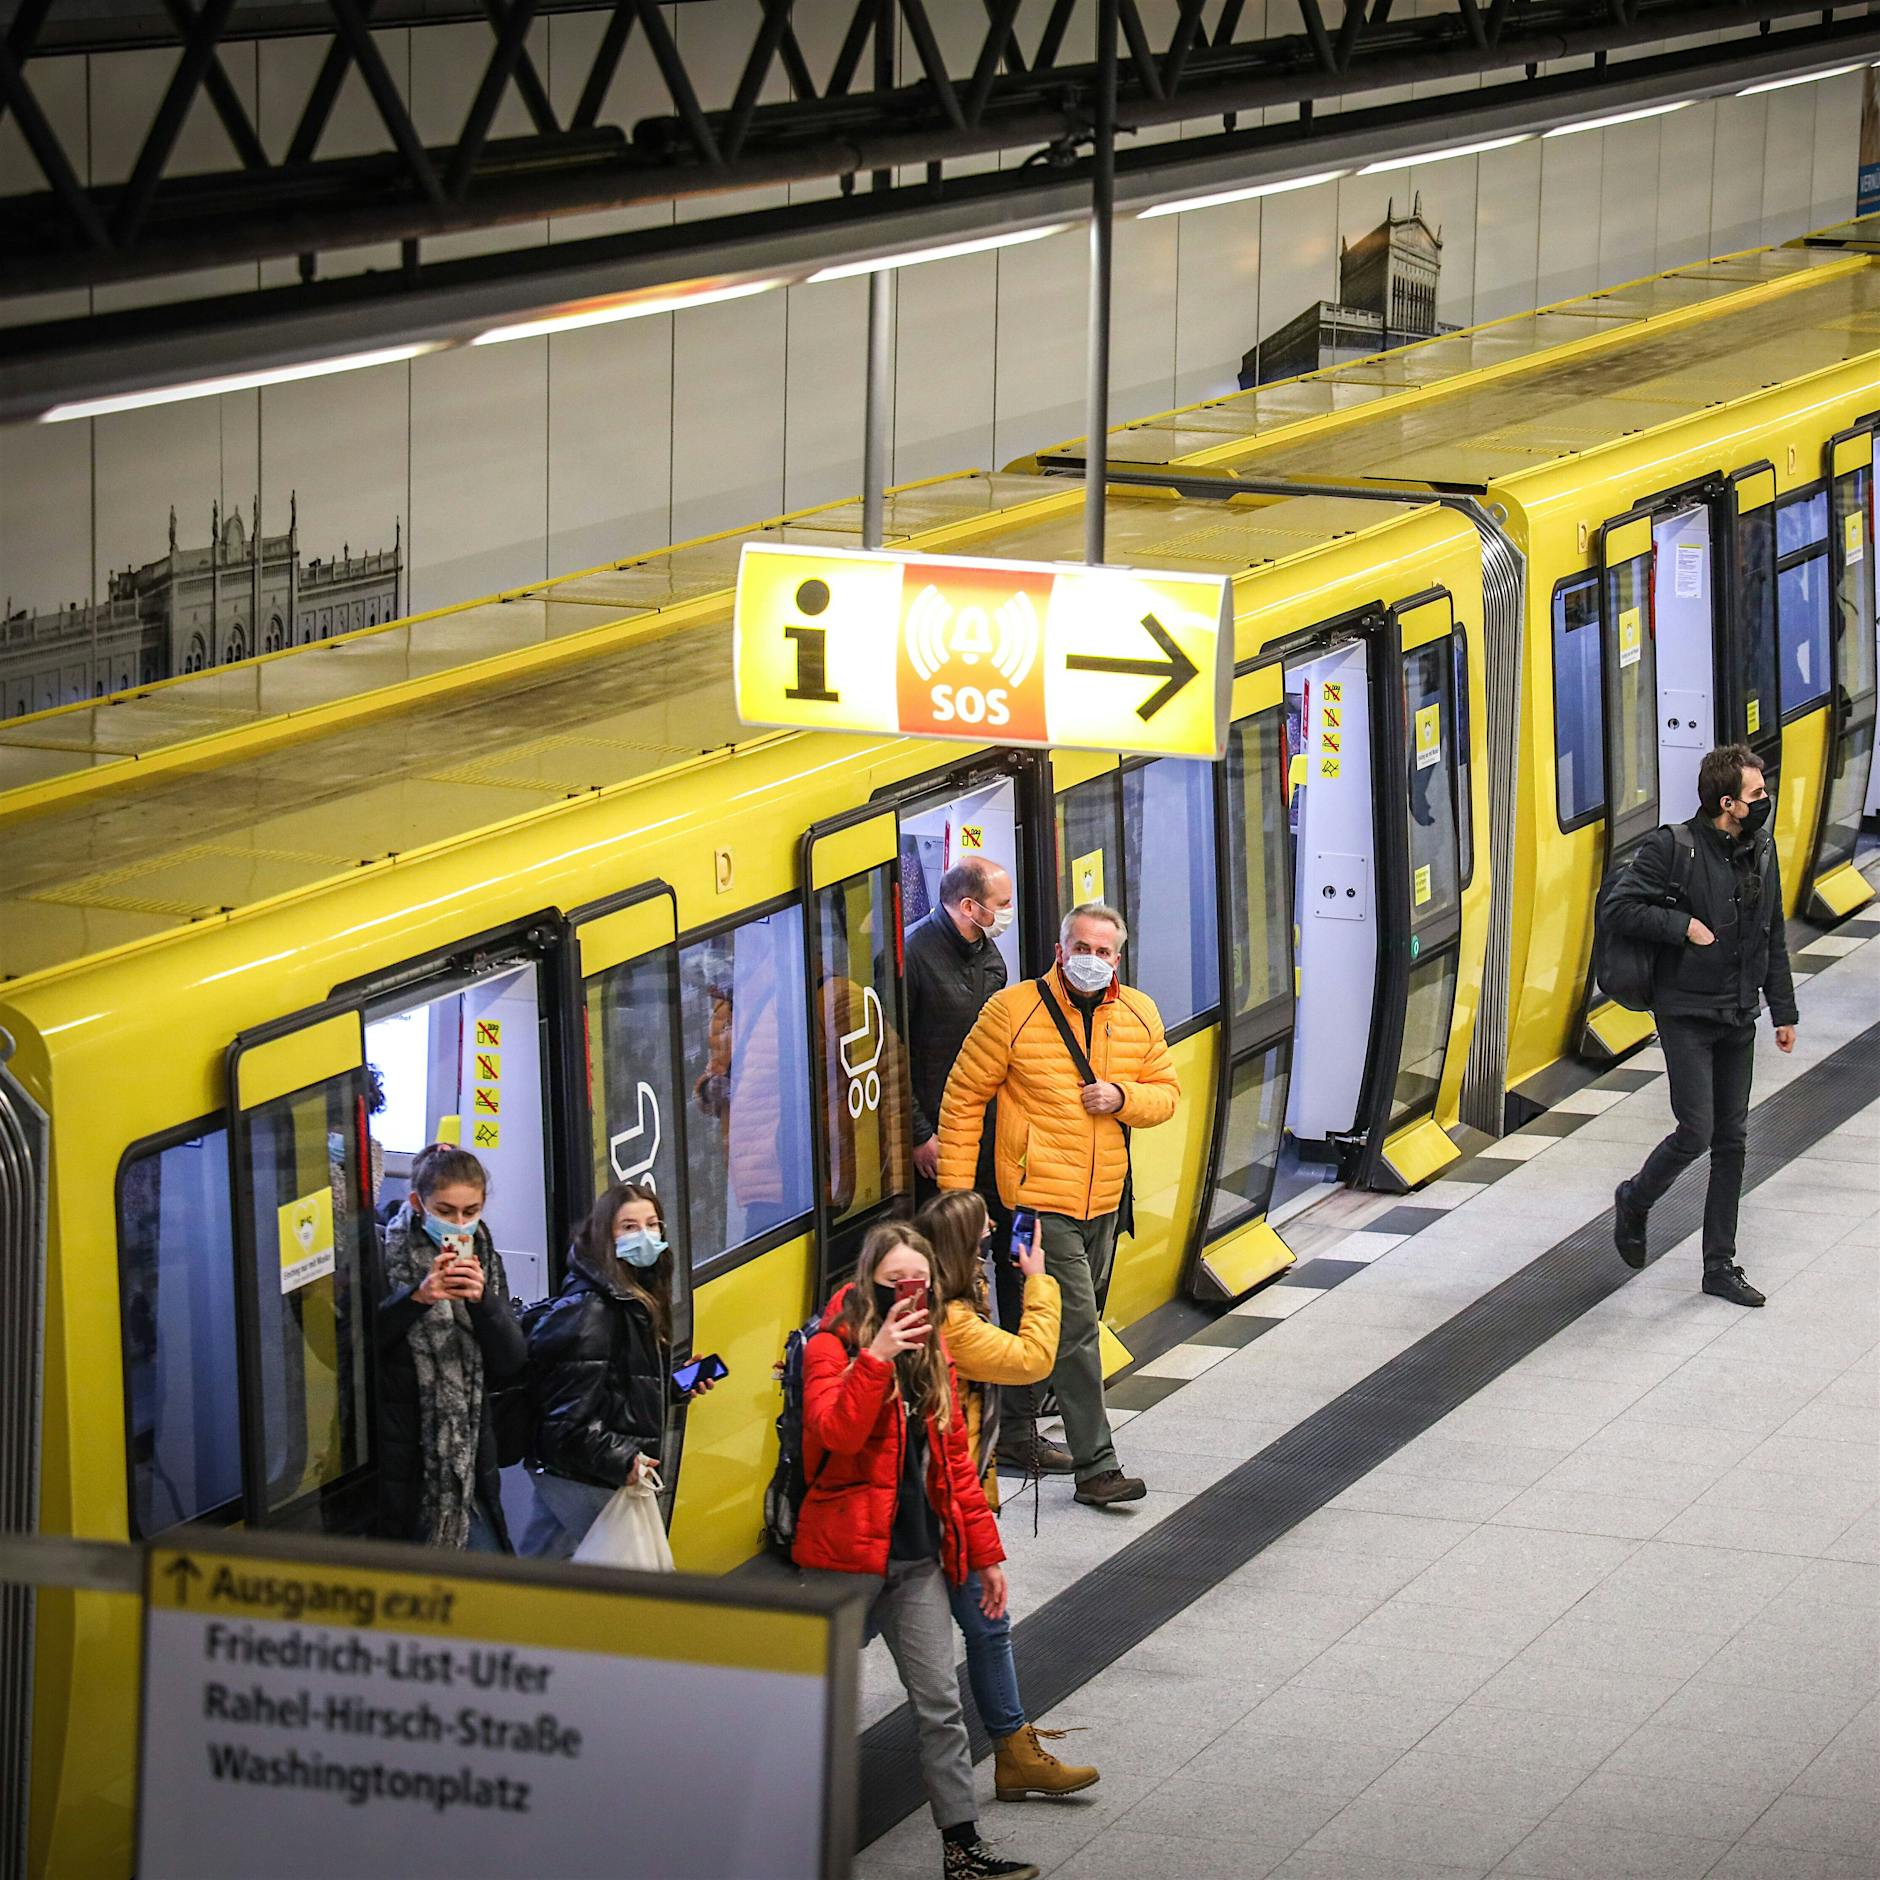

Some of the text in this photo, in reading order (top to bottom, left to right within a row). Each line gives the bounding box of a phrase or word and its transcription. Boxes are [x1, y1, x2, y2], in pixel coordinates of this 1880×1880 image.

[931, 684, 1010, 725] SOS
[211, 1567, 455, 1626] Ausgang exit
[205, 1623, 553, 1693] Friedrich-List-Ufer
[204, 1682, 583, 1758] Rahel-Hirsch-Straße
[207, 1744, 531, 1813] Washingtonplatz
